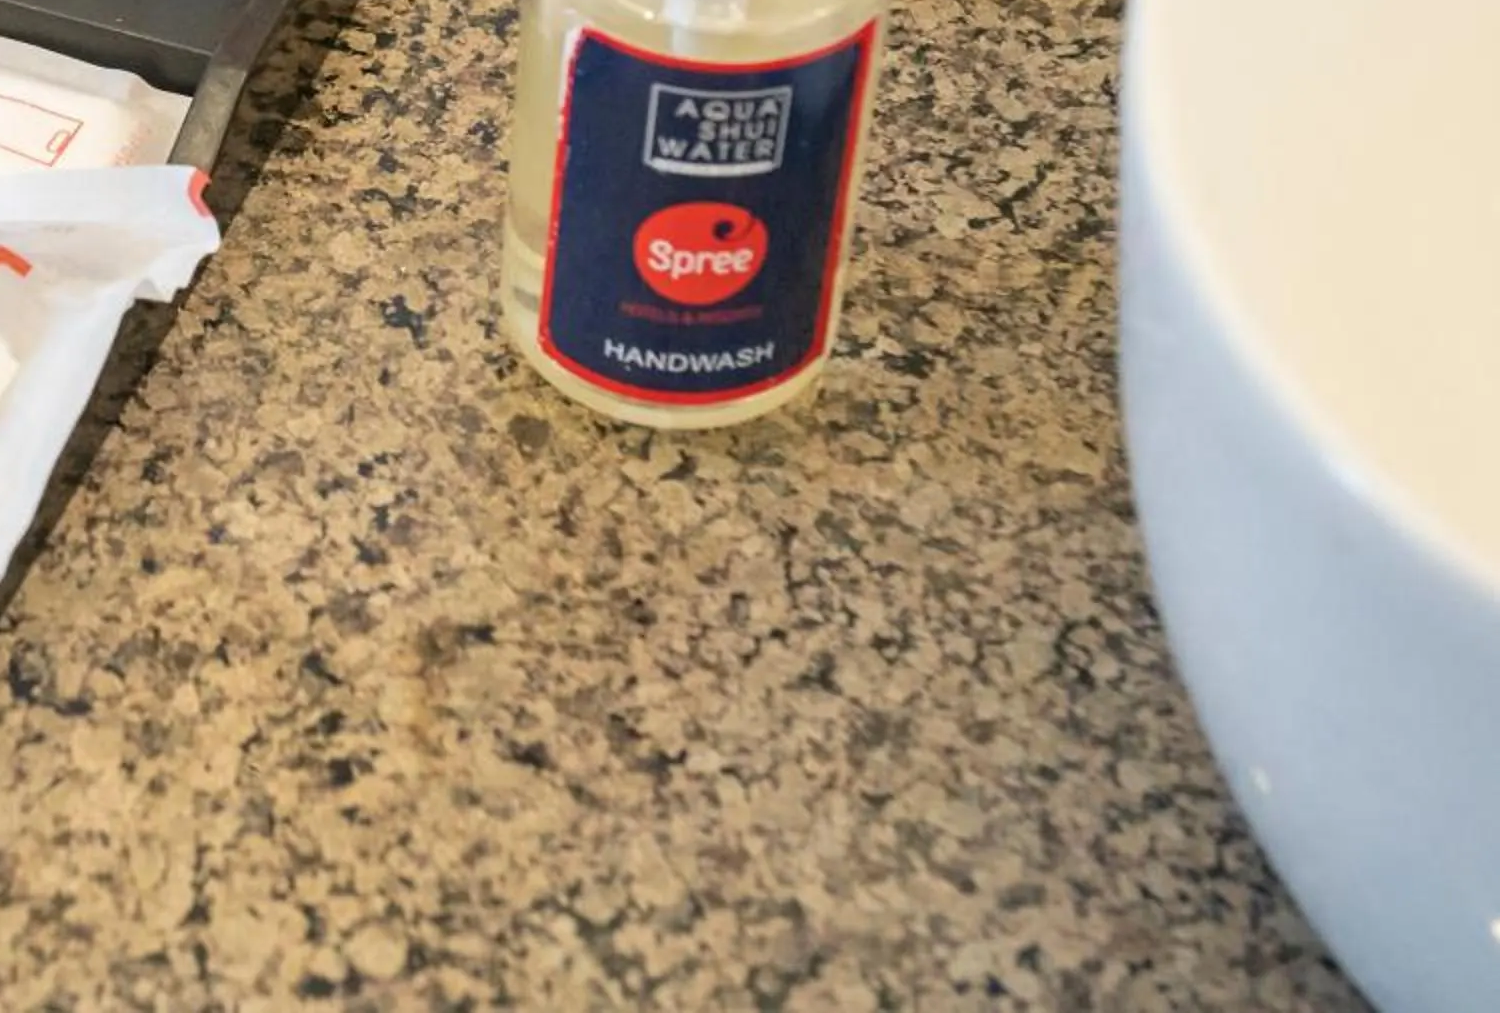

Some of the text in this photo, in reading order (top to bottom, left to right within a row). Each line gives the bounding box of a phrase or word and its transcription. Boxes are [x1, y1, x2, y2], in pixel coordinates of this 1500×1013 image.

[675, 98, 779, 122] AQUA
[697, 117, 777, 141] SHUI
[657, 135, 775, 161] WATER
[647, 239, 754, 280] Spree
[603, 338, 776, 374] HANDWASH
